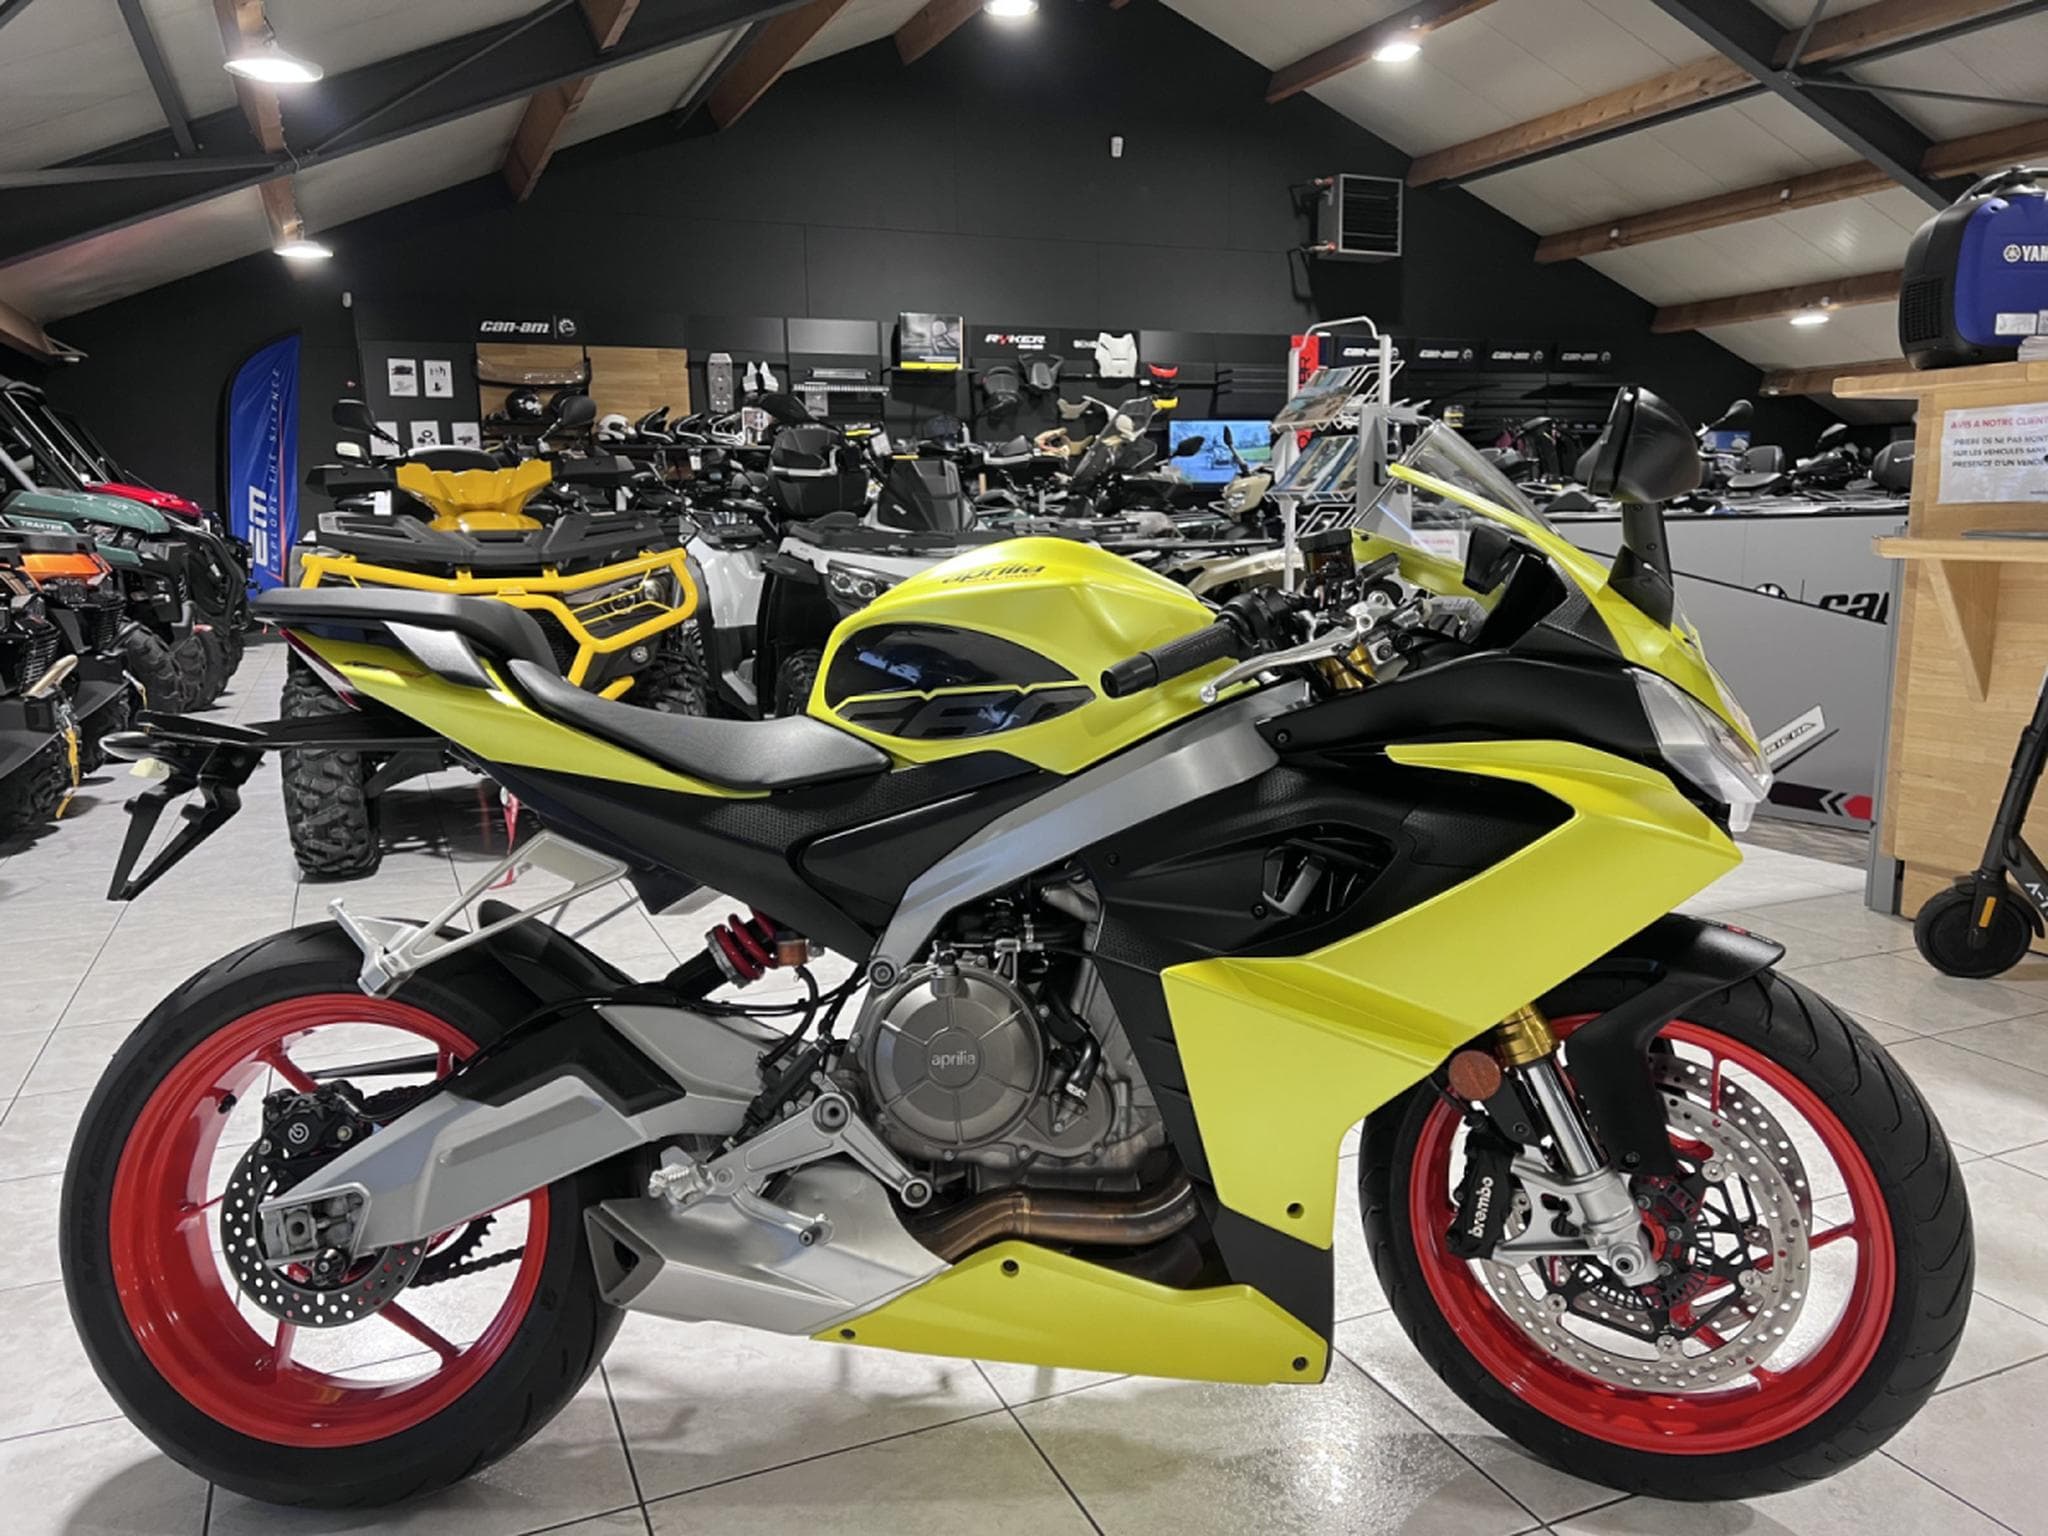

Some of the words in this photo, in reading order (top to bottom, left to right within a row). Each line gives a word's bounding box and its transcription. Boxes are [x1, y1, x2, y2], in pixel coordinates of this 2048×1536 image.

[480, 320, 549, 334] can-am
[1982, 417, 2013, 427] NOTRE
[269, 496, 279, 573] EXPLORE
[931, 1049, 976, 1070] aprilia
[1467, 1176, 1495, 1239] brembo
